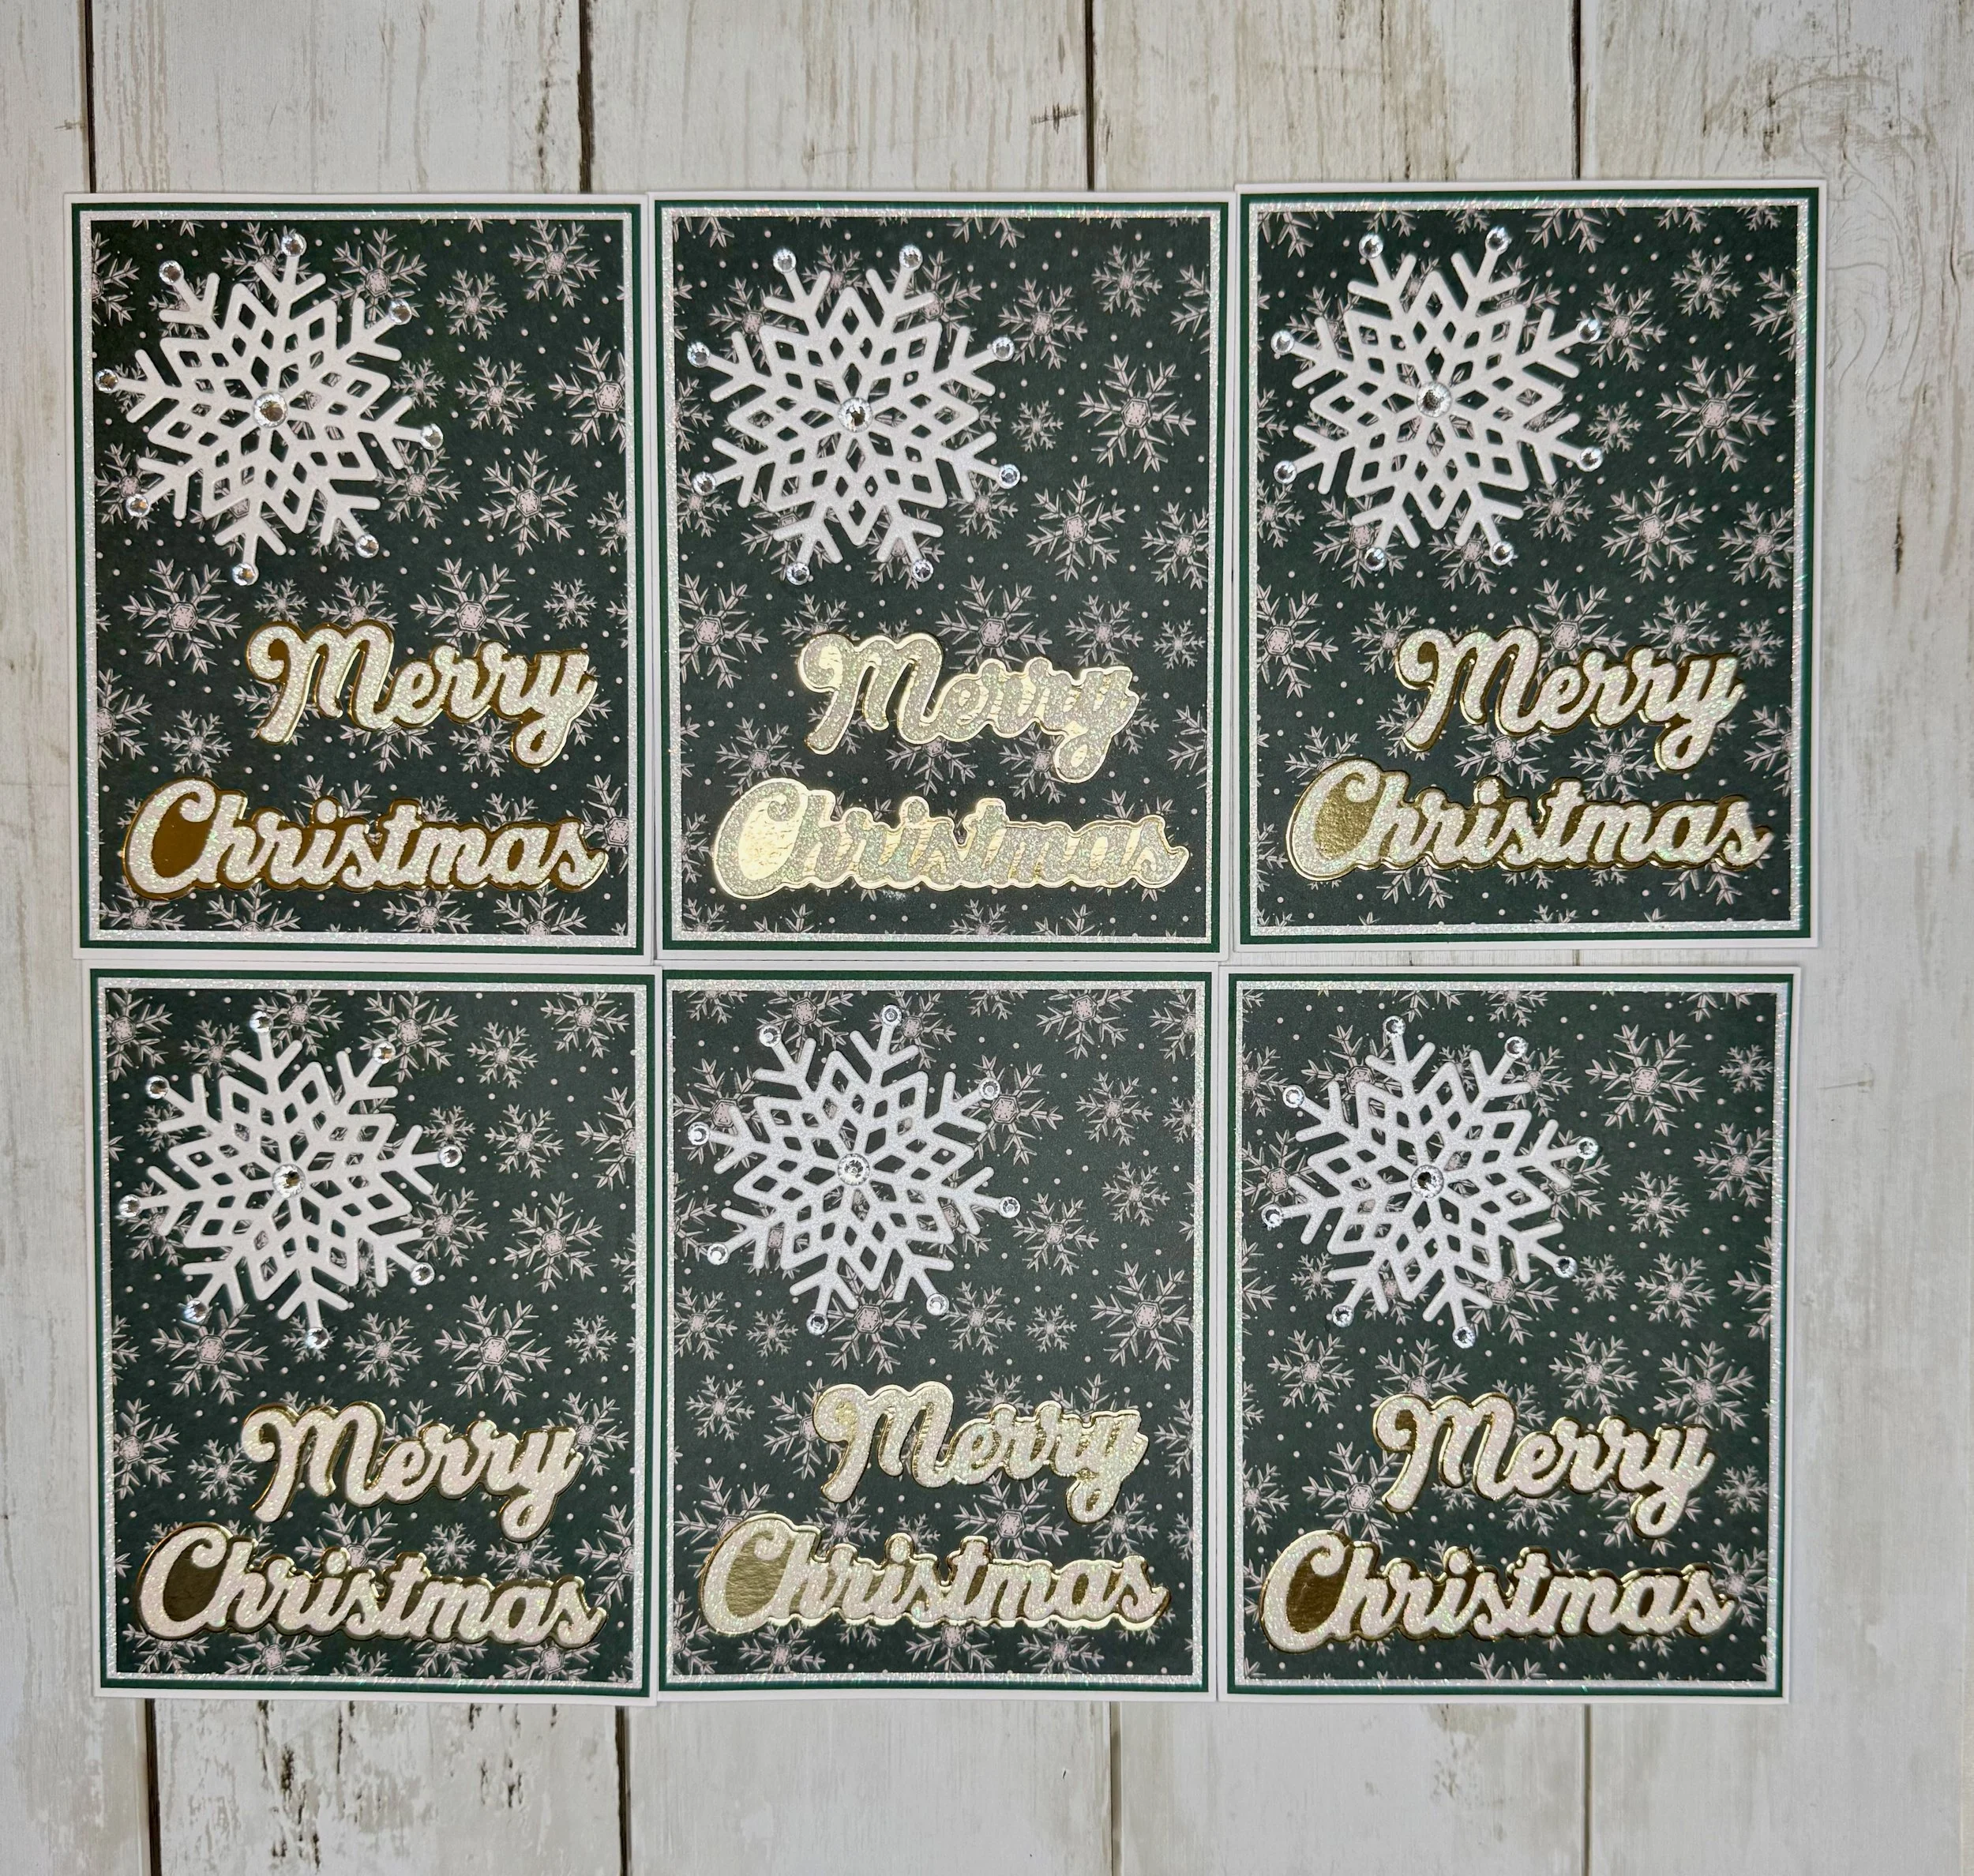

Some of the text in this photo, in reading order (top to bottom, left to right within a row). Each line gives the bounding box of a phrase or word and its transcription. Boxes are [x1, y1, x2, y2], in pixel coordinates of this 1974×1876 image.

[246, 623, 595, 766] Merry
[801, 633, 1139, 780] Merry
[1394, 628, 1743, 768] Merry
[129, 779, 610, 895] Christmas
[713, 778, 1188, 898] Christmas
[1287, 761, 1772, 877] Christmas
[241, 1403, 582, 1540] Merry
[814, 1383, 1147, 1521] Merry
[1374, 1395, 1713, 1536] Merry
[137, 1524, 607, 1648] Christmas
[701, 1514, 1168, 1634] Christmas
[1263, 1531, 1735, 1651] Christmas
